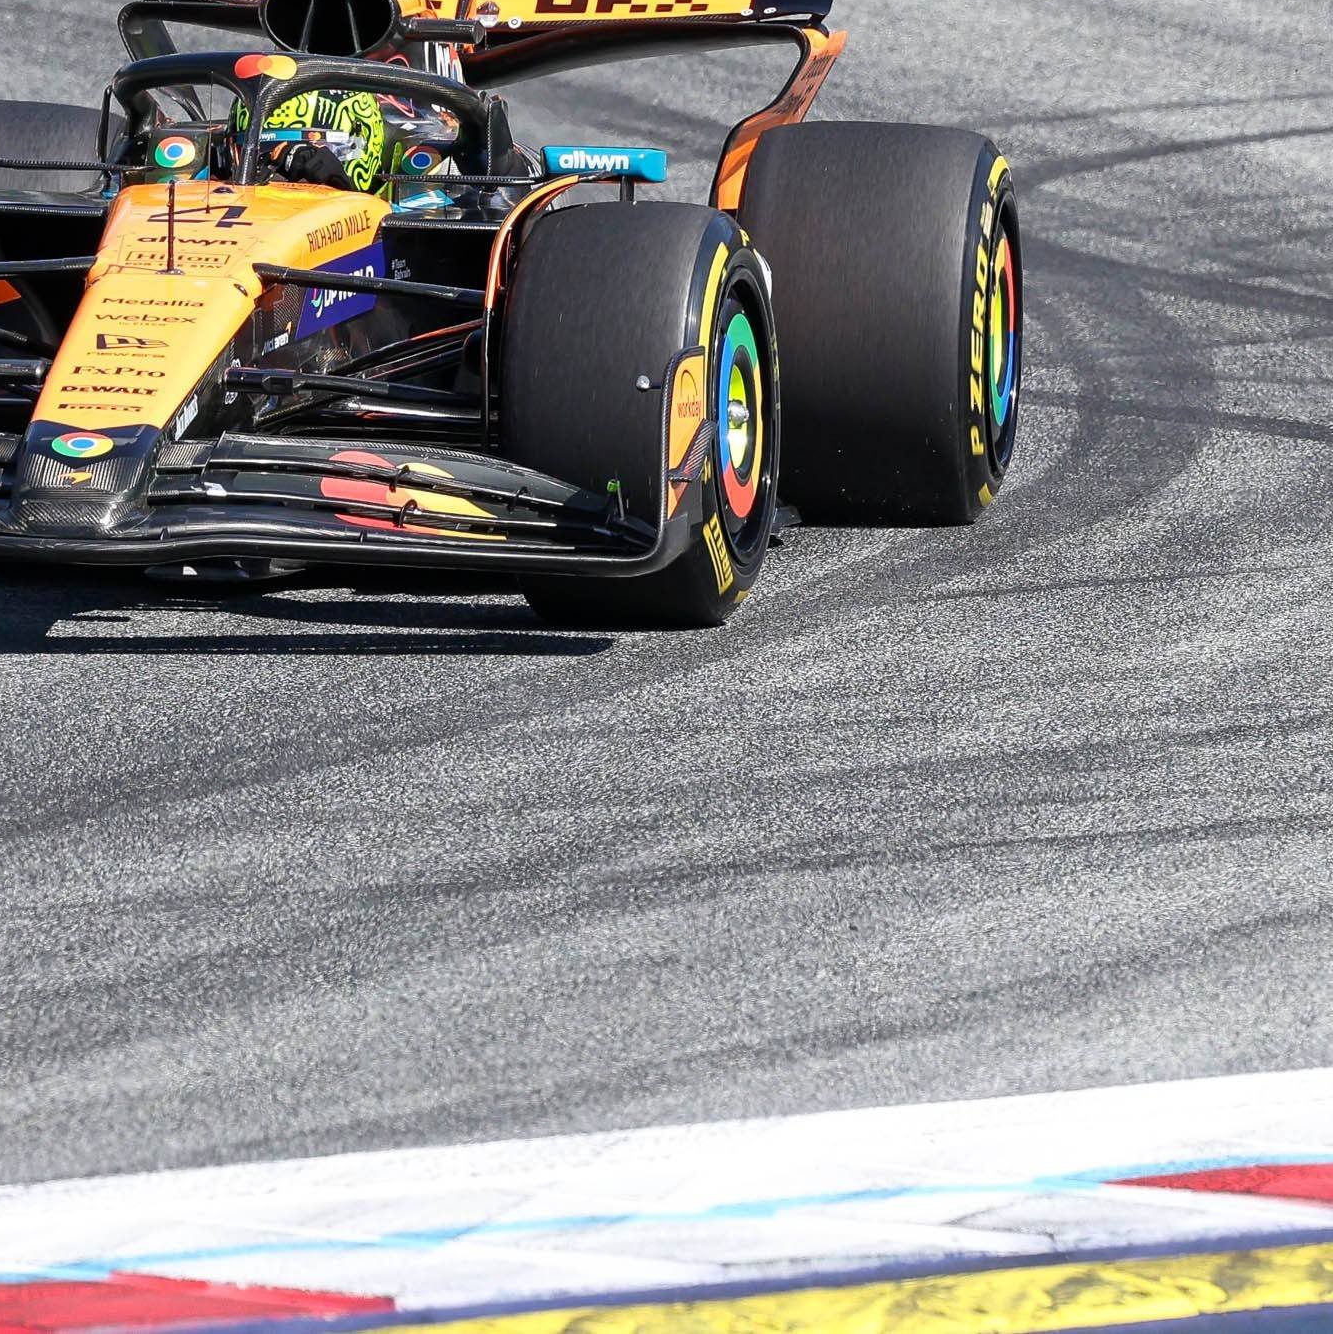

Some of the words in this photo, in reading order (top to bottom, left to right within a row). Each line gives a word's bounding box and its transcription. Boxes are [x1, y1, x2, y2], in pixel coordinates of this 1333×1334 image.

[558, 150, 630, 171] allwyn
[306, 220, 344, 254] RICHARD
[344, 209, 371, 237] MILLE
[137, 253, 220, 263] Hiton
[102, 297, 206, 307] Medallia
[95, 314, 197, 323] webex
[970, 242, 989, 415] ZERO
[69, 365, 165, 378] FxPro
[970, 425, 984, 456] P
